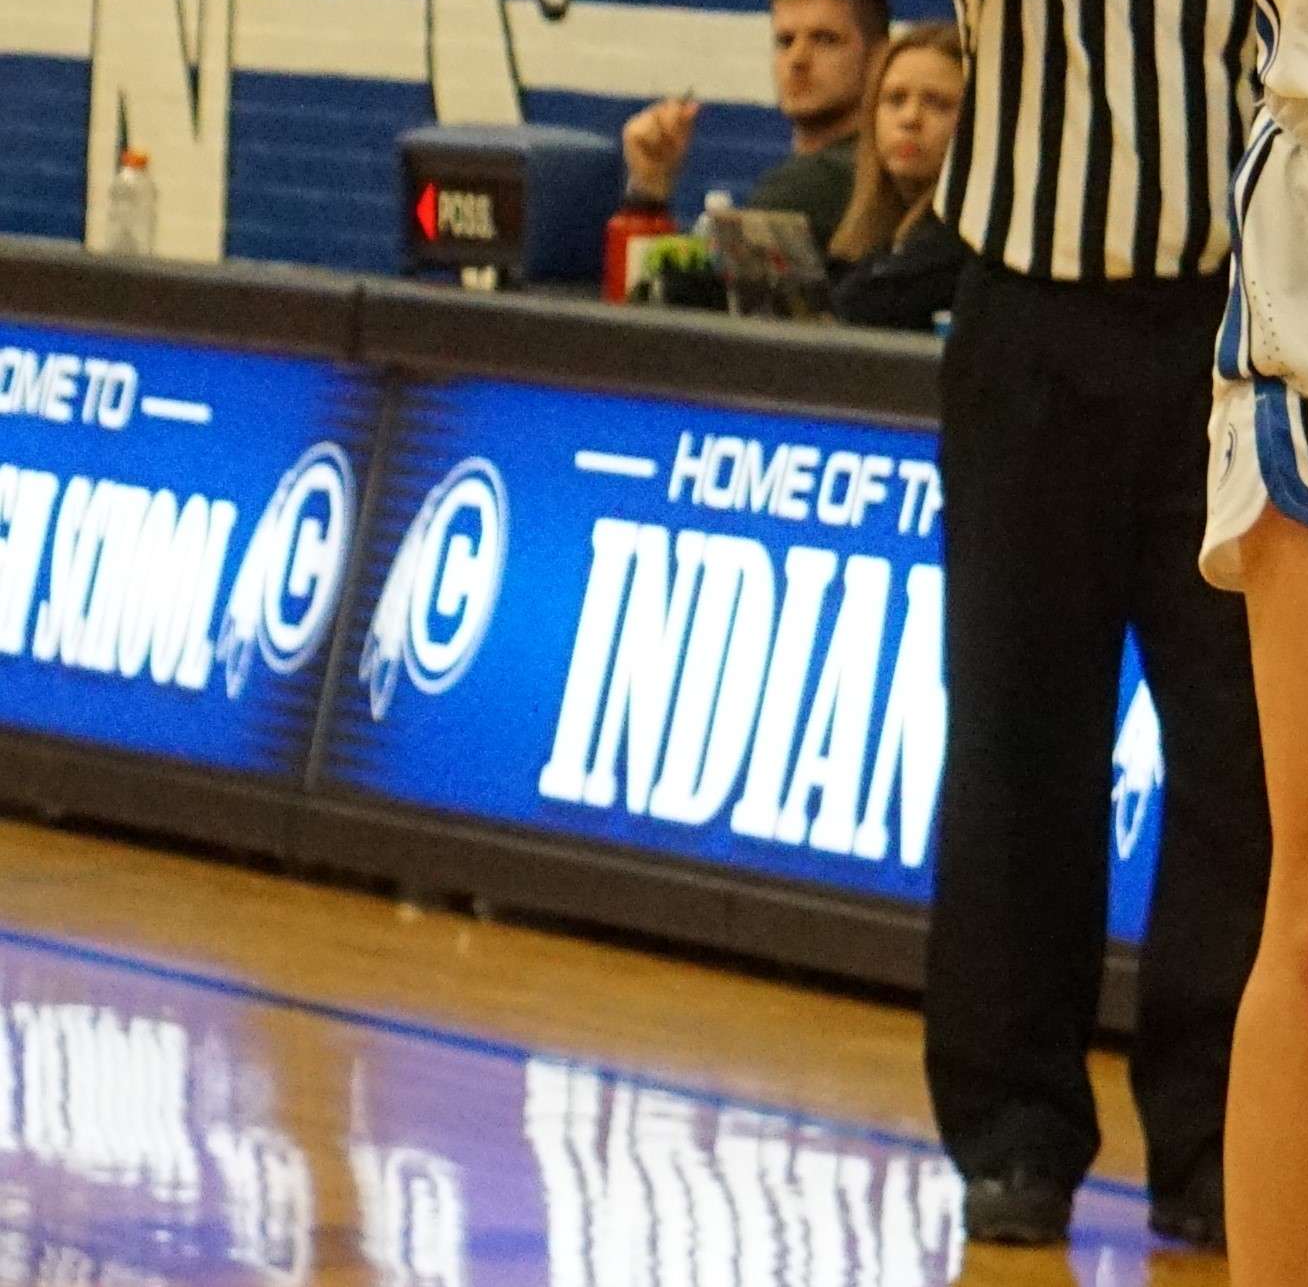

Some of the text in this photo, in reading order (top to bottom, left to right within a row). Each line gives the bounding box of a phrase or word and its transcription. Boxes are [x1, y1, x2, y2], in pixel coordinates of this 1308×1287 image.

[81, 357, 138, 430] TO
[668, 431, 821, 520] HOME
[816, 451, 895, 527] OF
[32, 475, 237, 690] SCHOOL
[538, 517, 949, 869] INDIAN
